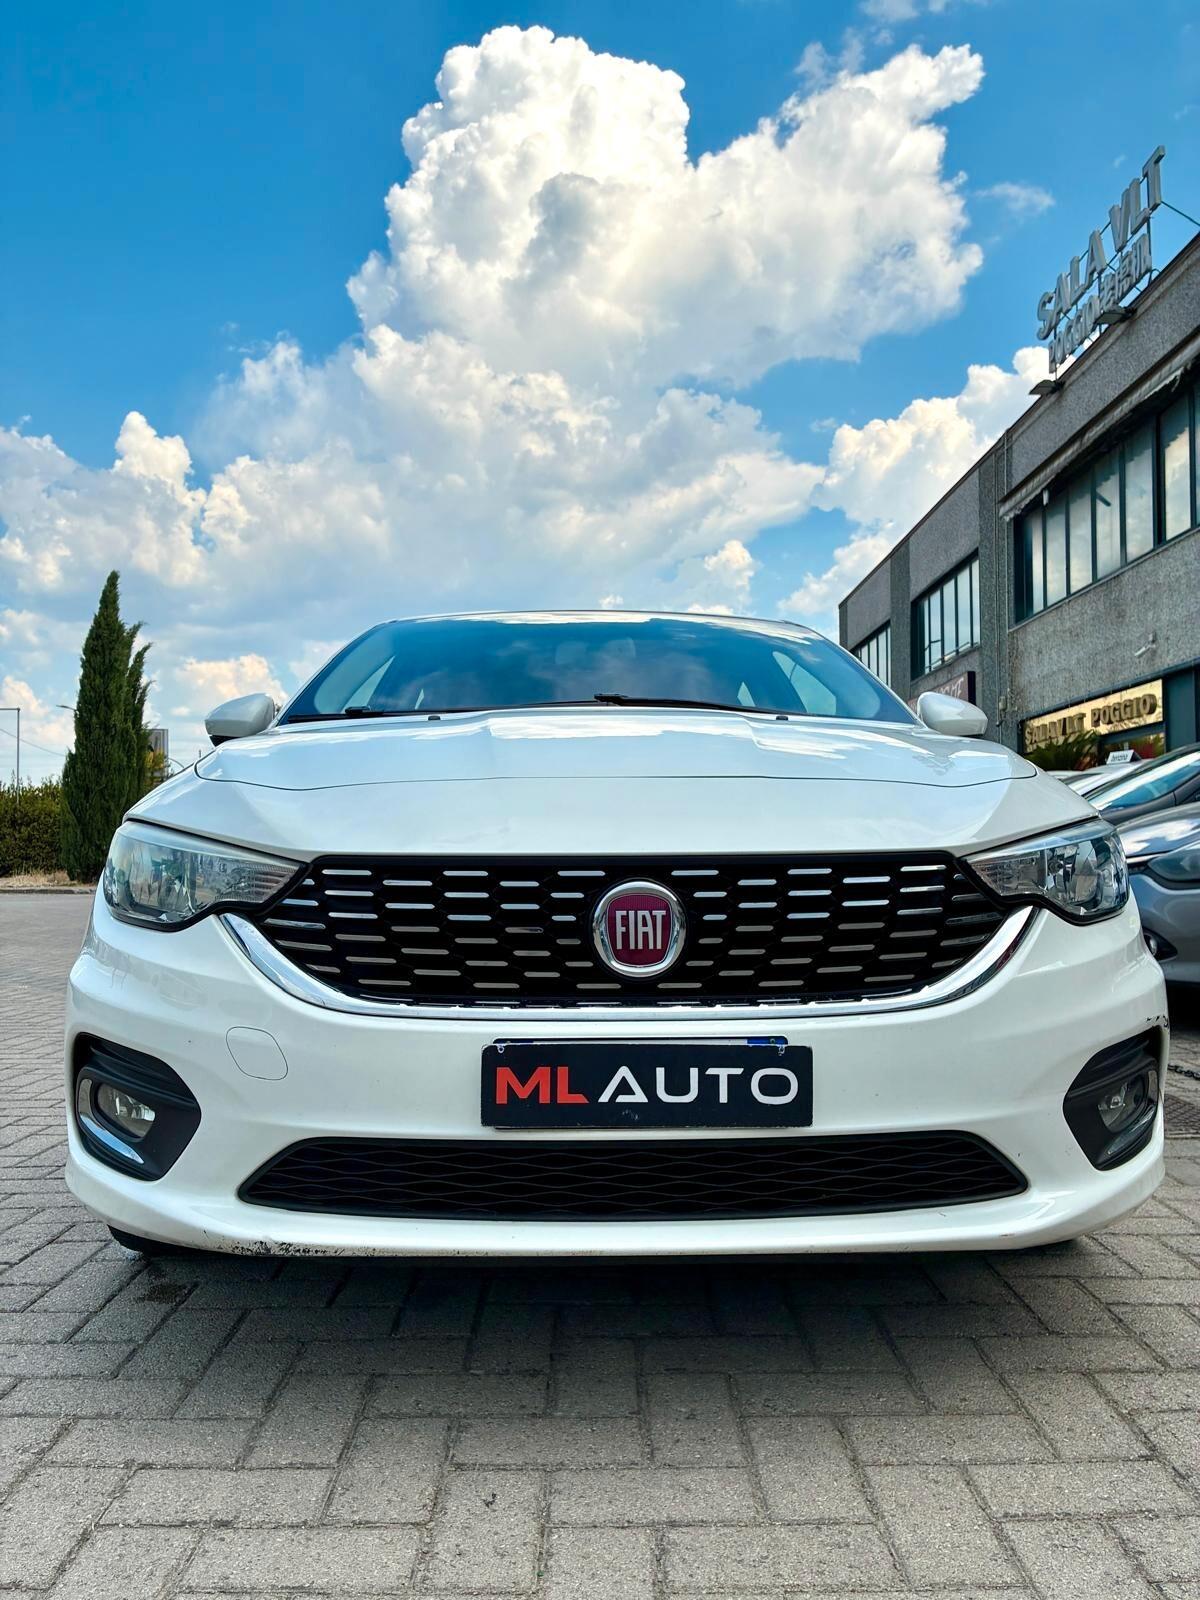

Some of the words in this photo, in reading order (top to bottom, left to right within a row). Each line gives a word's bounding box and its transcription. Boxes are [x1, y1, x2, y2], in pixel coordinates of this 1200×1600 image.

[1037, 228, 1107, 341] SALA
[1109, 145, 1165, 253] VLT
[1090, 693, 1157, 728] POGGIO
[615, 910, 667, 950] FIAT
